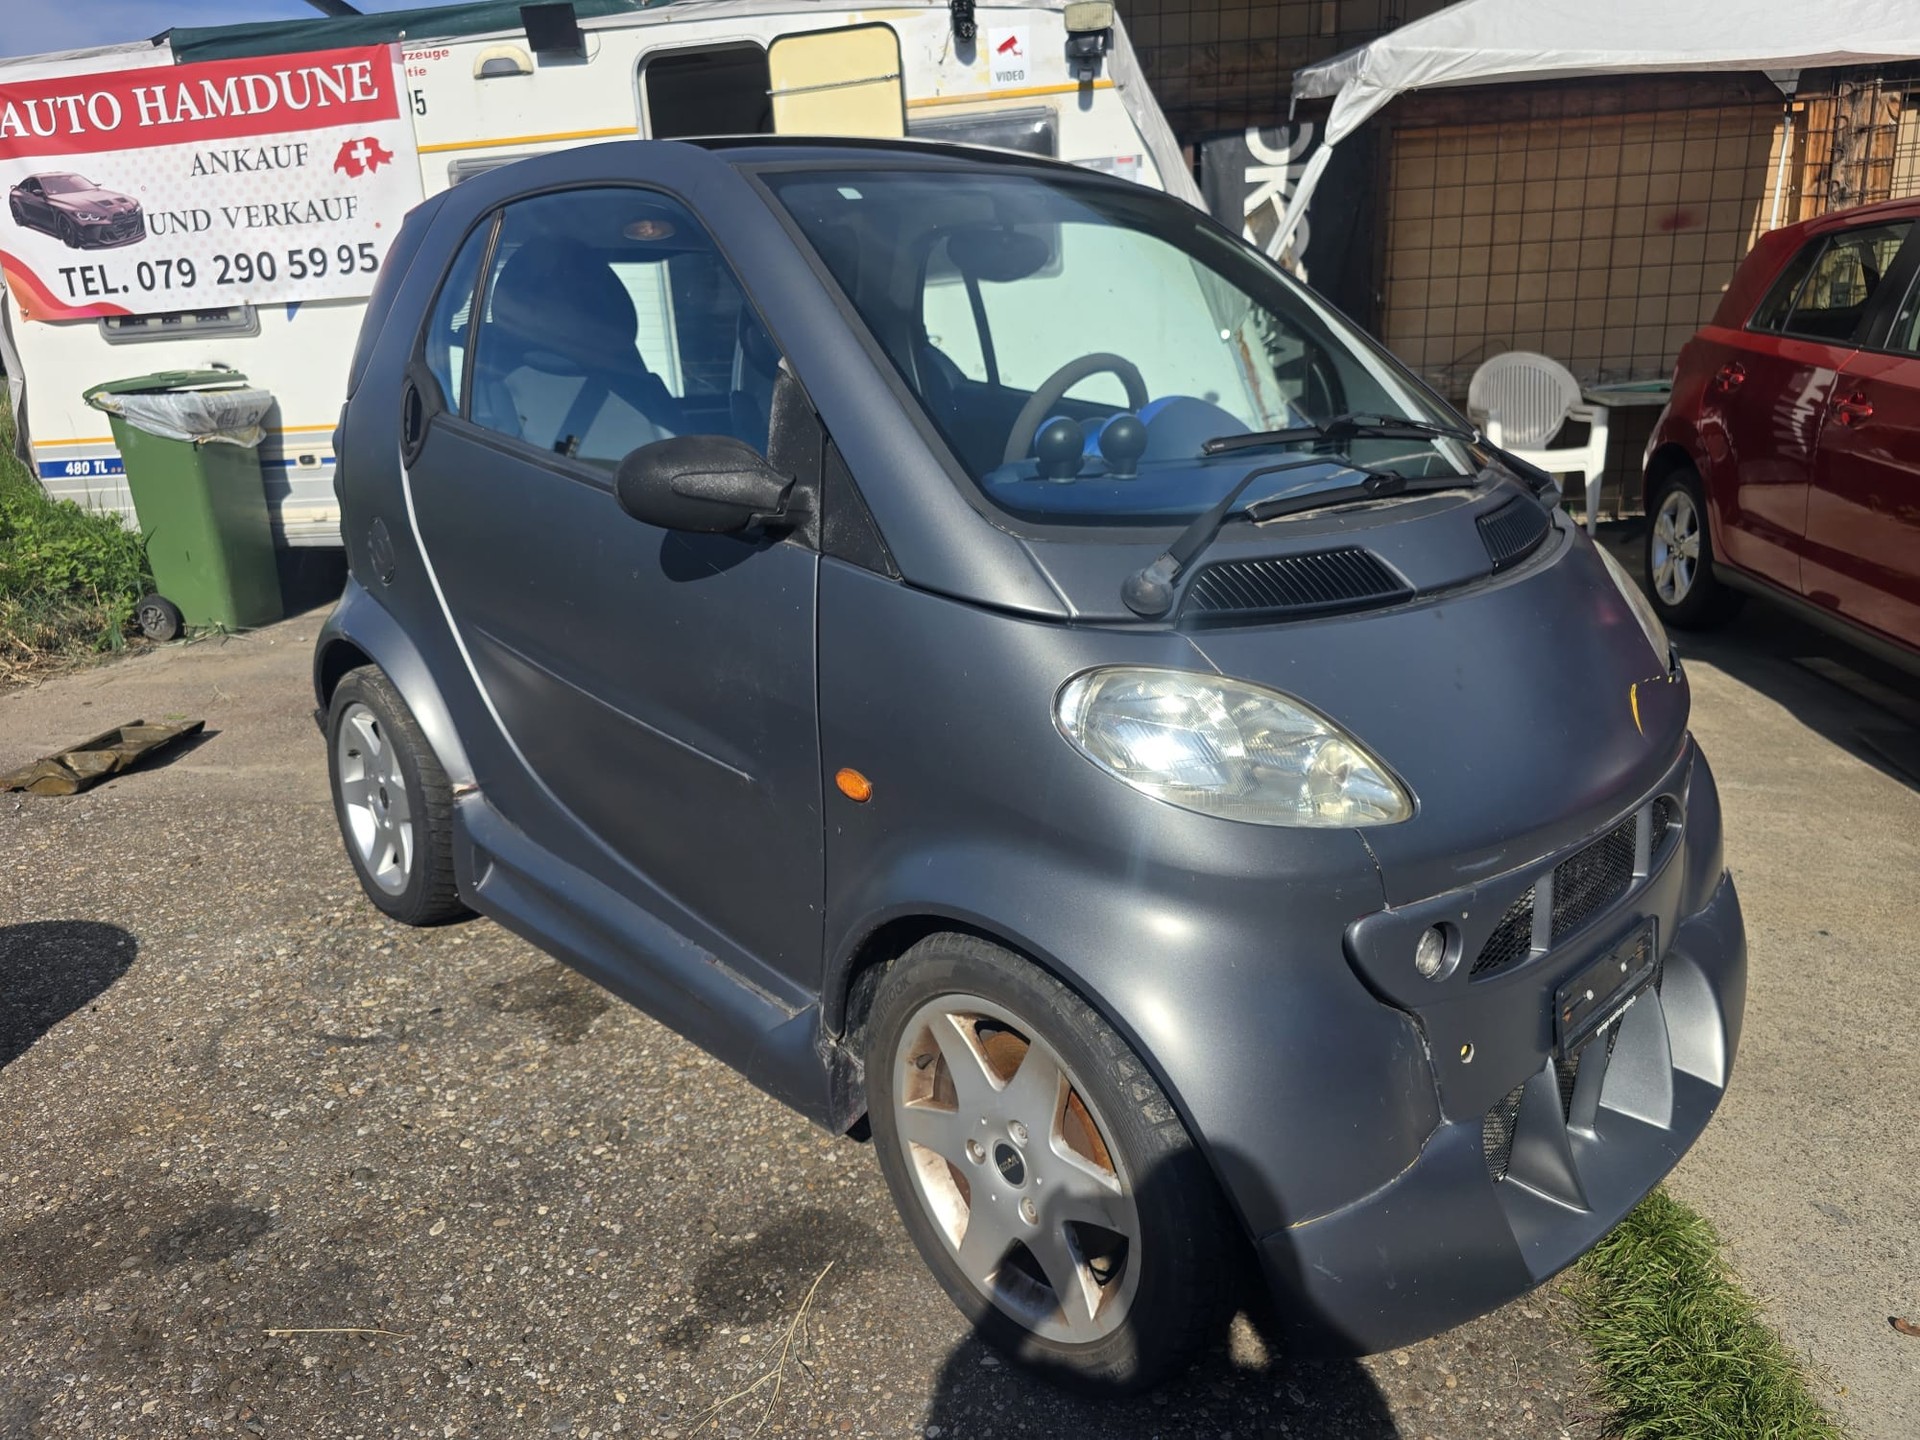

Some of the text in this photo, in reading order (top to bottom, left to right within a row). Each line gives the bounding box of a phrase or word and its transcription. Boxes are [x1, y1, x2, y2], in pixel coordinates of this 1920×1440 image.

[996, 70, 1025, 82] VIDEO
[0, 61, 379, 139] AUTO HAMDUNE
[190, 143, 309, 177] ANKAUF
[148, 196, 359, 237] UND VERKAUF
[59, 242, 379, 297] TEL. 079 290 59 95
[65, 461, 90, 475] 480
[94, 460, 108, 474] TL
